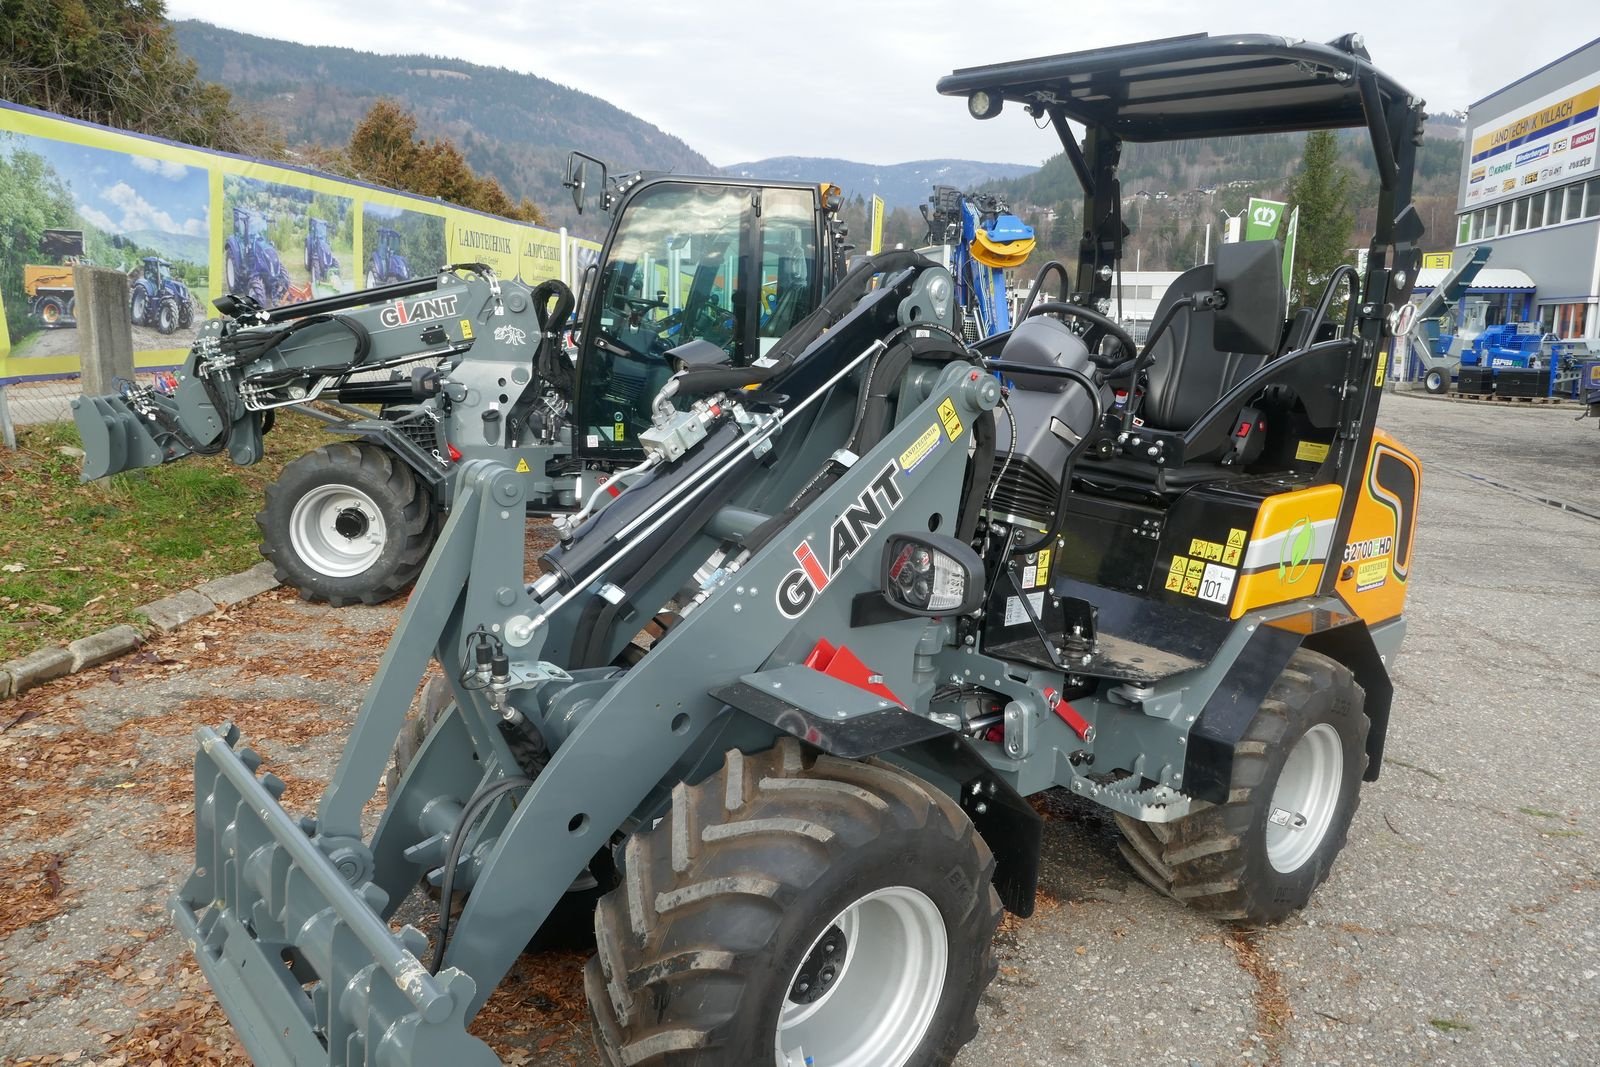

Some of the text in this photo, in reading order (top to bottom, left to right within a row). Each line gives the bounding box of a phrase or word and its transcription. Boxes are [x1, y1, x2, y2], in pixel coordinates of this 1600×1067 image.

[1490, 100, 1574, 146] LANDTECHNIK VILLACH
[1552, 140, 1568, 152] JCB
[458, 228, 512, 255] LANDTECHNIK
[523, 242, 560, 262] ANDTECHNI
[901, 427, 937, 463] LANDTECHNIK
[1203, 580, 1222, 600] 101
